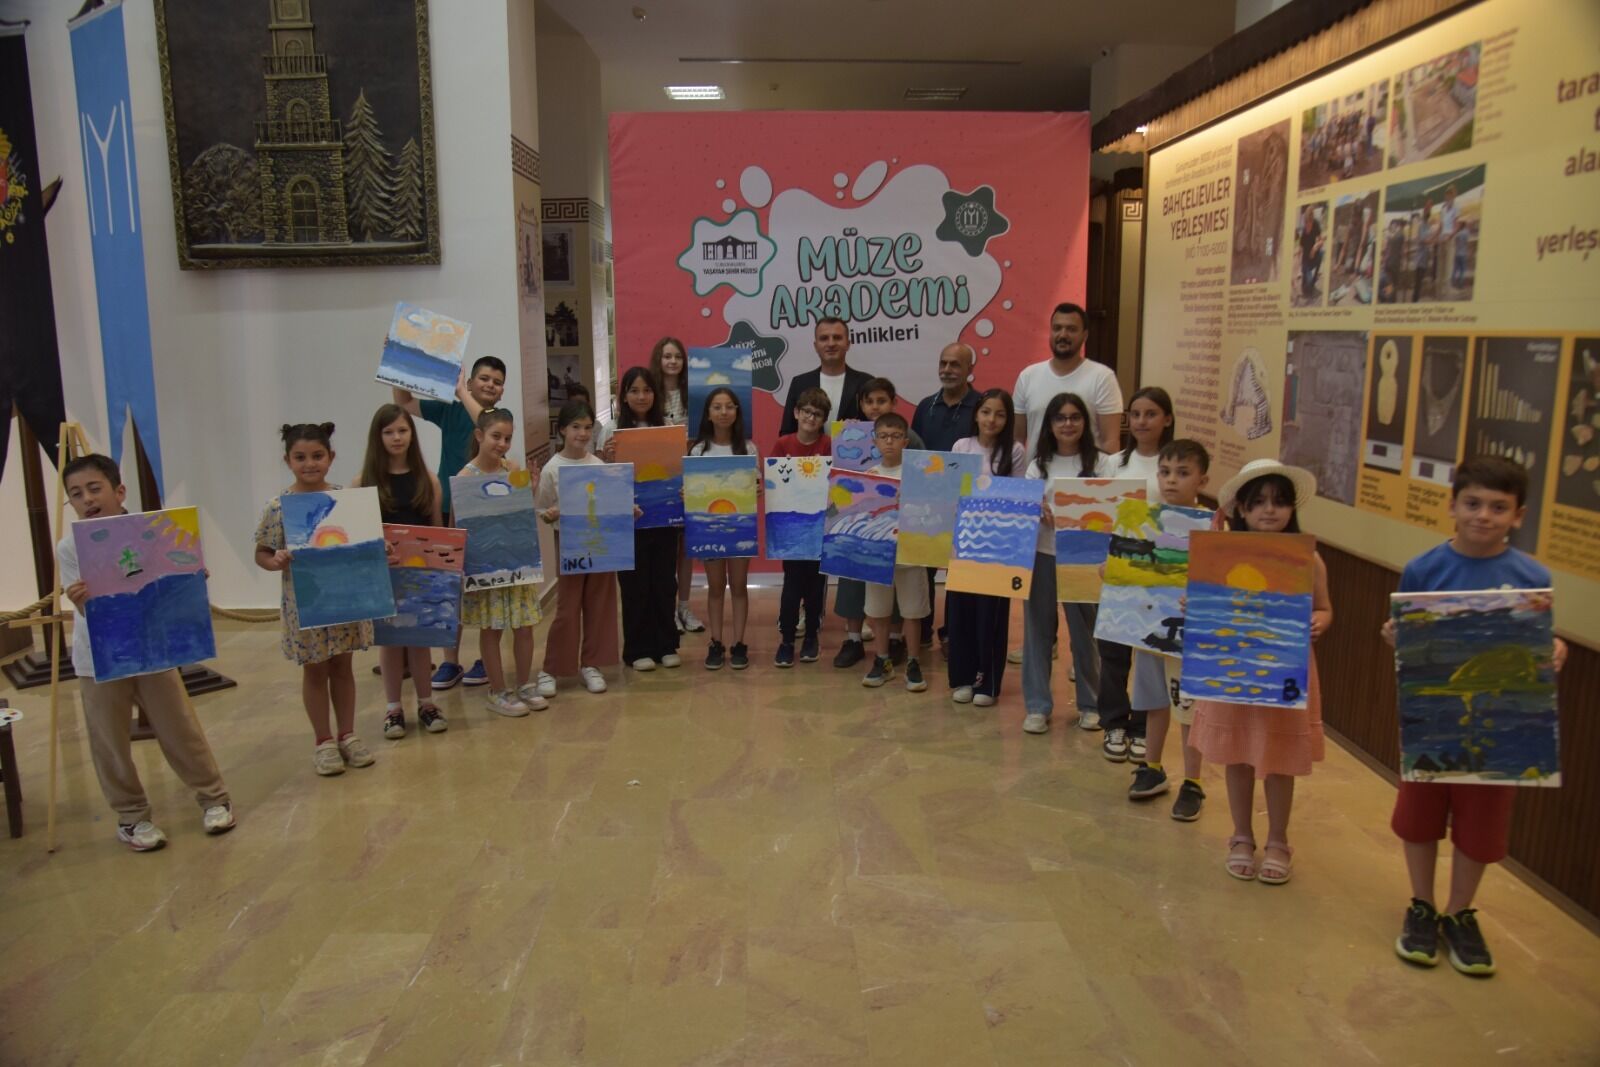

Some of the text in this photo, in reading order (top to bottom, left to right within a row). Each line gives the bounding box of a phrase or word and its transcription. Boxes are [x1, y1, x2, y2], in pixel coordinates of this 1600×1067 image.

[1564, 145, 1600, 176] ala
[1162, 176, 1231, 217] BAHÇELİEVLER
[1170, 207, 1230, 244] YERLEŞMESİ
[1537, 225, 1600, 261] yerleş
[850, 323, 919, 345] inlikleri
[1011, 576, 1023, 591] B
[1282, 678, 1301, 701] B
